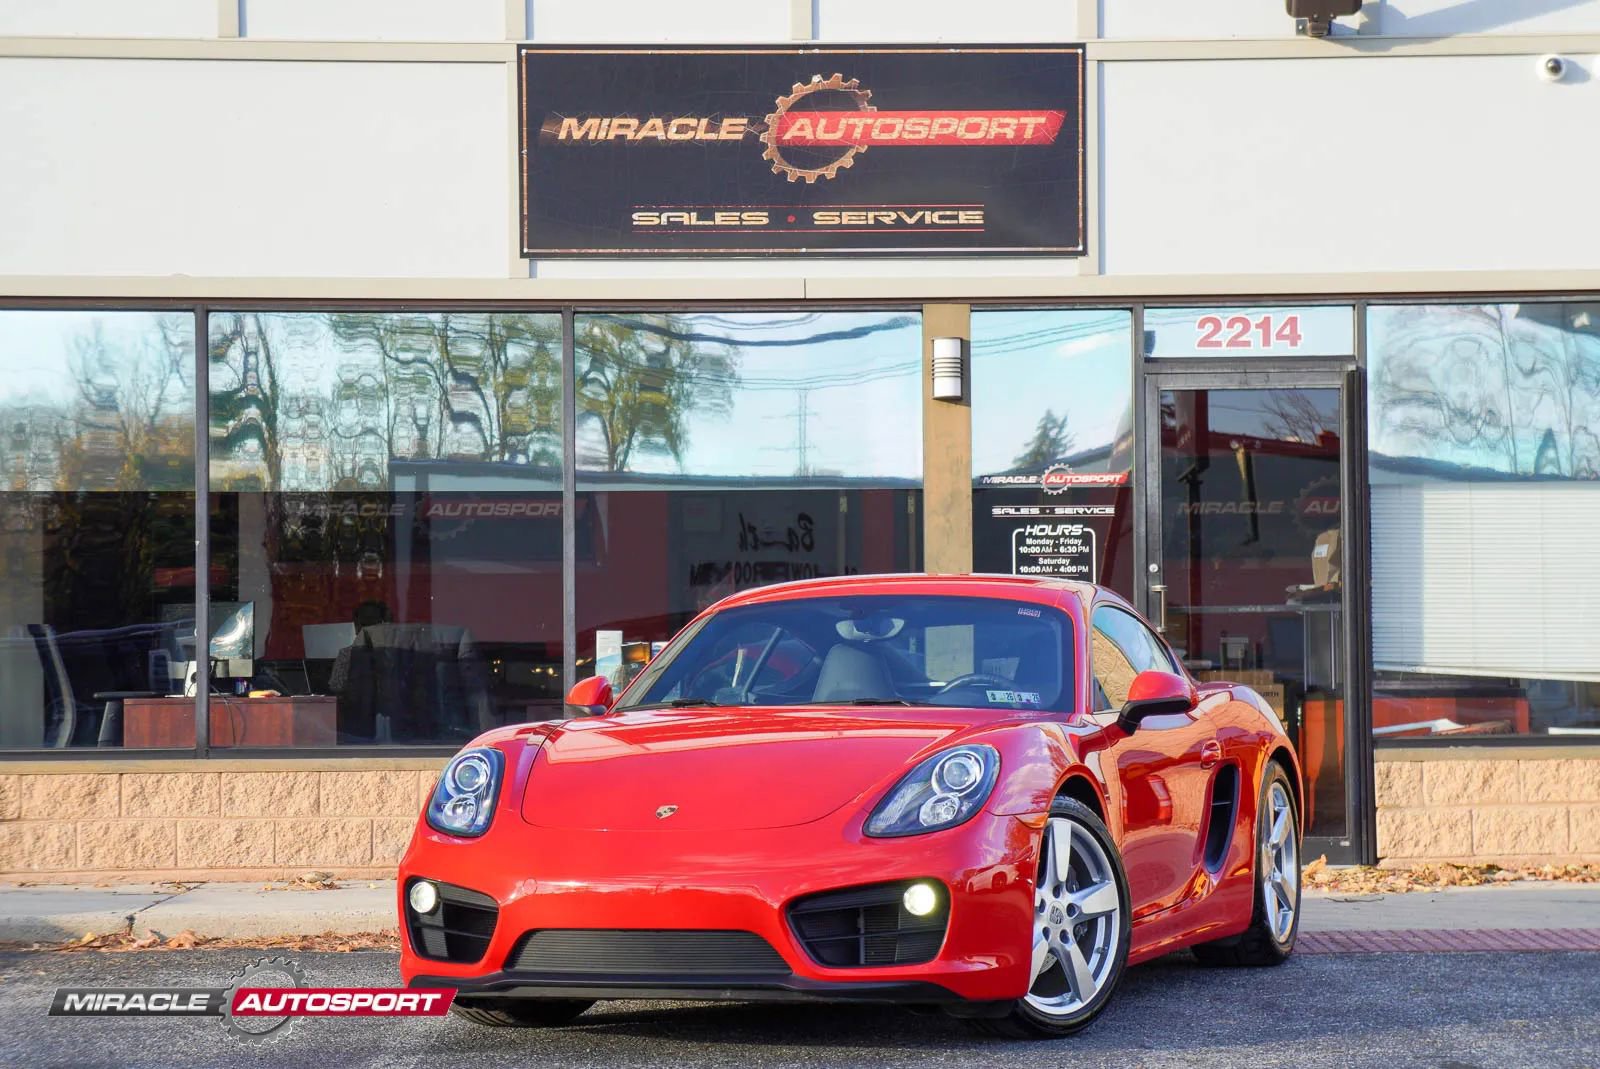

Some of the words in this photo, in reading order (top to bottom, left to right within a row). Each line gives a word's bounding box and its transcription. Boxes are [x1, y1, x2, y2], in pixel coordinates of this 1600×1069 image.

[557, 117, 749, 140] MIRACLE
[782, 116, 1047, 140] AUTOSPORT
[632, 211, 769, 225] SALES
[812, 210, 984, 225] SERVICE
[1196, 315, 1302, 349] 2214
[983, 476, 1037, 484] MIRACLE
[1047, 475, 1121, 483] AUTOSPORT
[1025, 524, 1083, 536] HOURS
[1026, 538, 1054, 546] Monday
[1060, 537, 1082, 546] Friday
